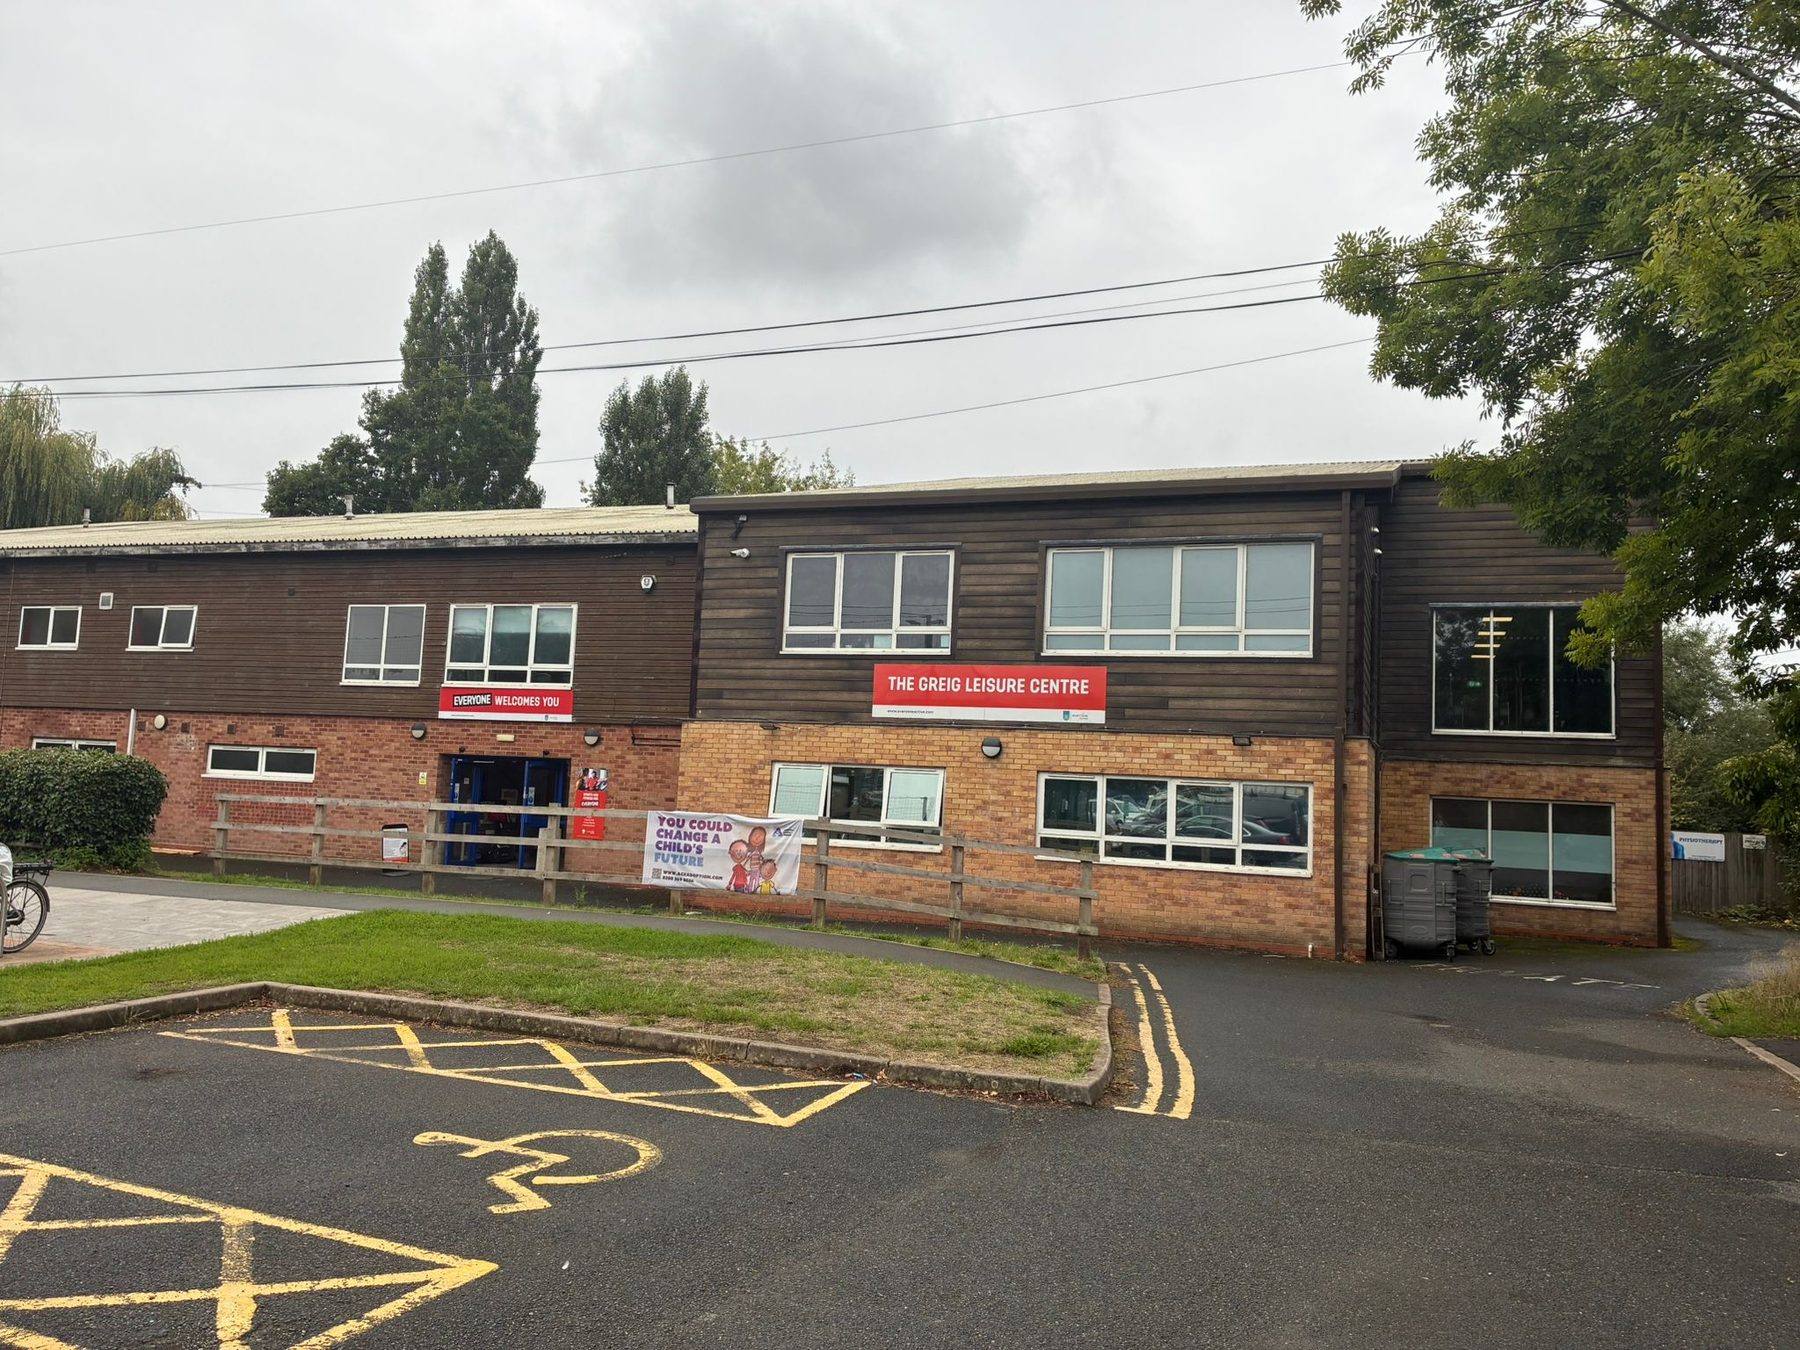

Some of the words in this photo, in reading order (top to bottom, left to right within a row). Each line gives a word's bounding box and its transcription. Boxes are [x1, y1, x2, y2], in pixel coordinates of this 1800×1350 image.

[888, 676, 915, 692] THE
[918, 676, 961, 693] GREIG
[965, 677, 1026, 694] LEISURE
[1030, 678, 1090, 695] CENTRE
[453, 694, 491, 706] EVERYONE
[494, 695, 541, 707] WELCOMES
[542, 696, 560, 707] YOU
[657, 816, 686, 829] YOU
[688, 819, 733, 832] COULD
[656, 828, 708, 843] CHANGE
[711, 833, 721, 844] A
[655, 840, 703, 855] CHILD'S
[654, 852, 704, 867] FUTURE
